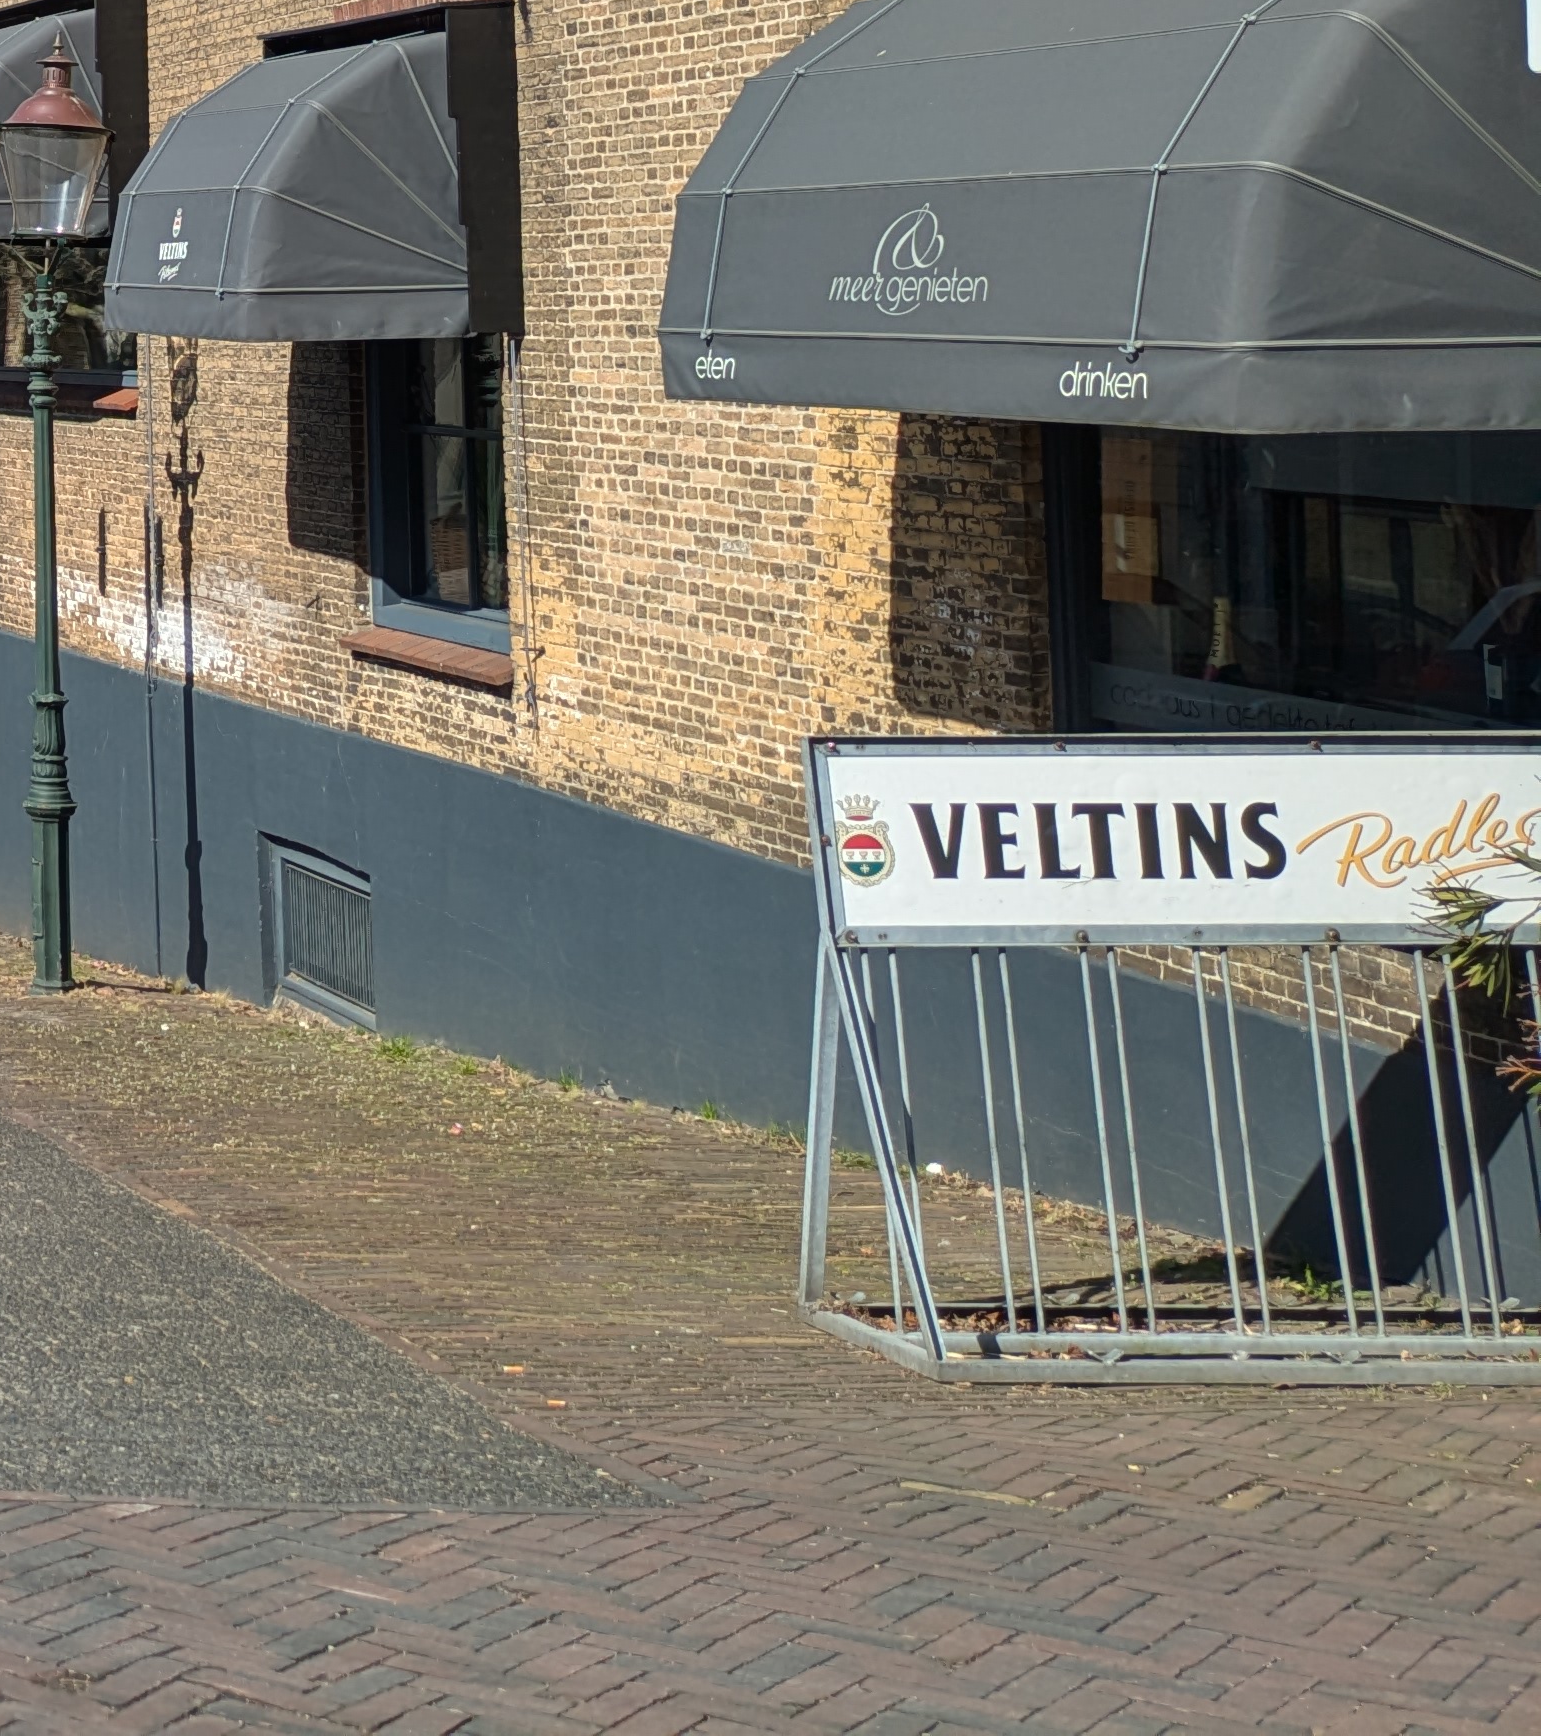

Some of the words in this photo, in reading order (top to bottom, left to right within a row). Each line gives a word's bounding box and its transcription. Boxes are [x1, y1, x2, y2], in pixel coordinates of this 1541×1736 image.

[159, 241, 189, 260] VELTINS
[695, 348, 736, 380] eten
[1059, 361, 1148, 399] drinken
[907, 800, 1288, 880] VELTINS
